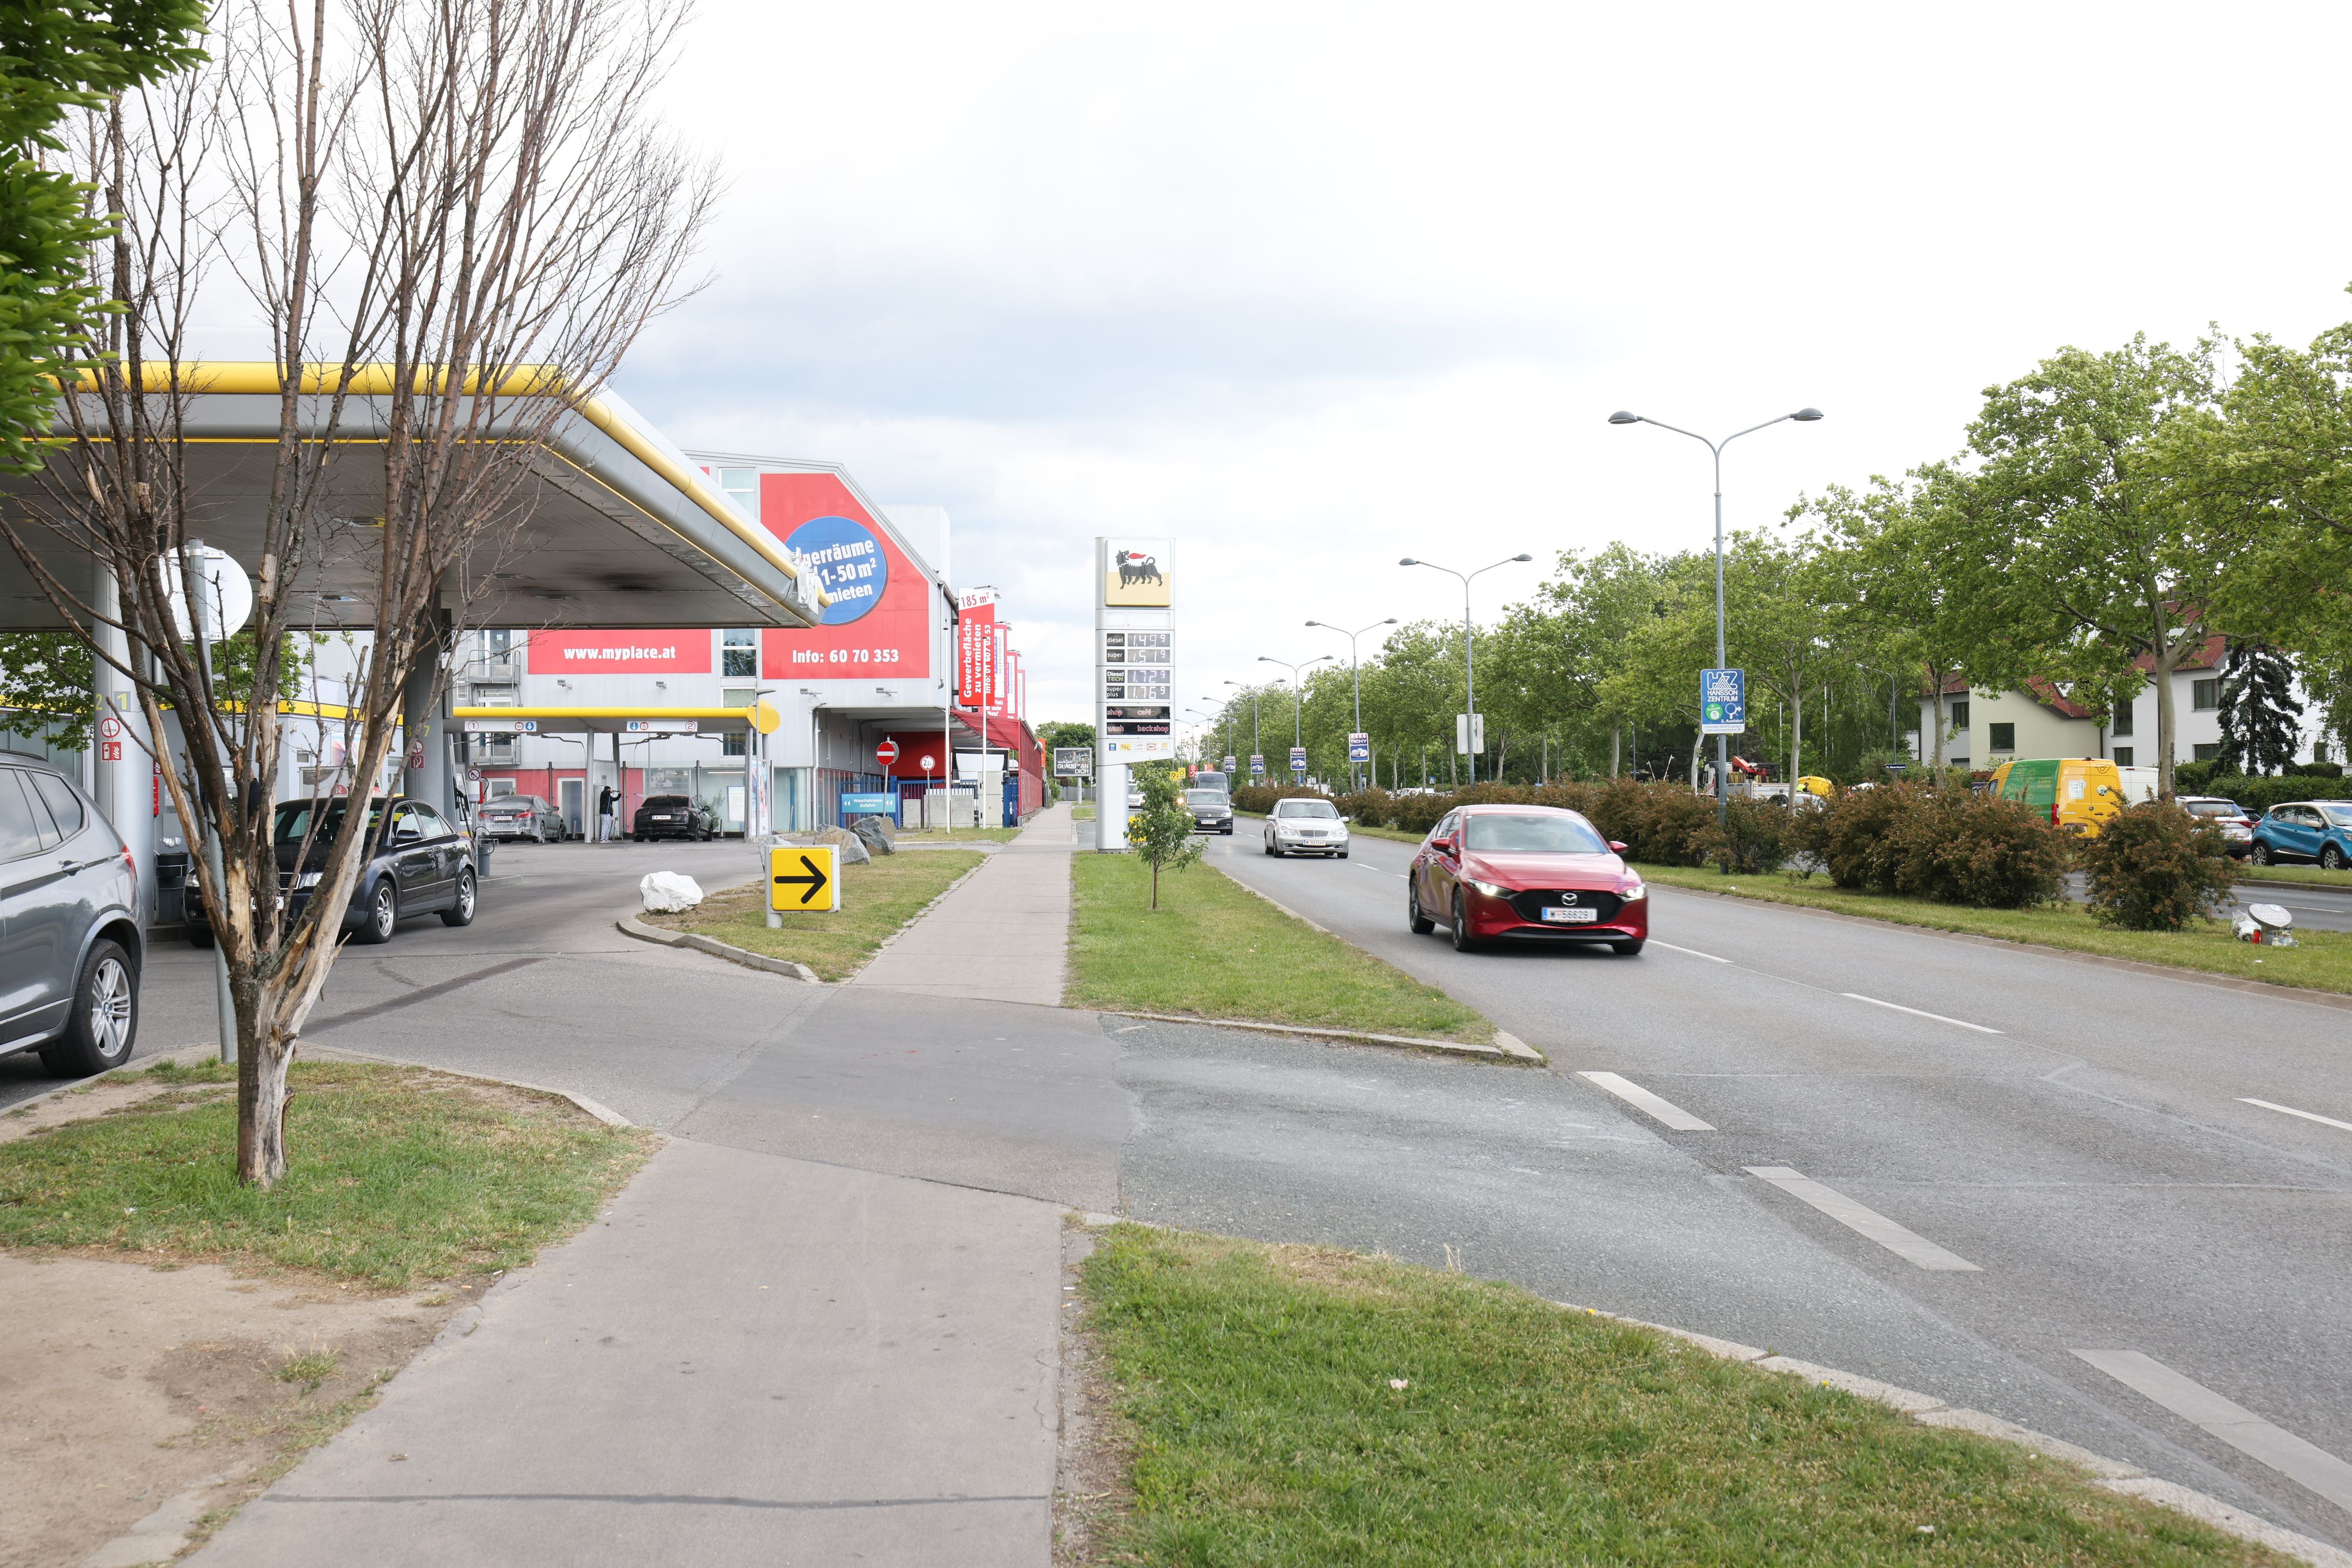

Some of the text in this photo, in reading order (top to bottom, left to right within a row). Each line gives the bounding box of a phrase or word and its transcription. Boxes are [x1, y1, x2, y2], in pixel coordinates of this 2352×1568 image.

[821, 563, 857, 586] 1-50
[826, 584, 873, 604] mieten
[961, 594, 977, 608] 185
[984, 624, 991, 634] 53
[563, 646, 676, 660] www.myplace.at
[792, 648, 899, 663] Info: 60 70 353
[963, 618, 972, 698] Gewerbefläche
[973, 624, 981, 693] zu vermieten
[96, 693, 102, 710] 2
[117, 693, 127, 710] 1
[1107, 708, 1122, 717] shop
[406, 726, 412, 737] 8
[423, 725, 430, 737] 7
